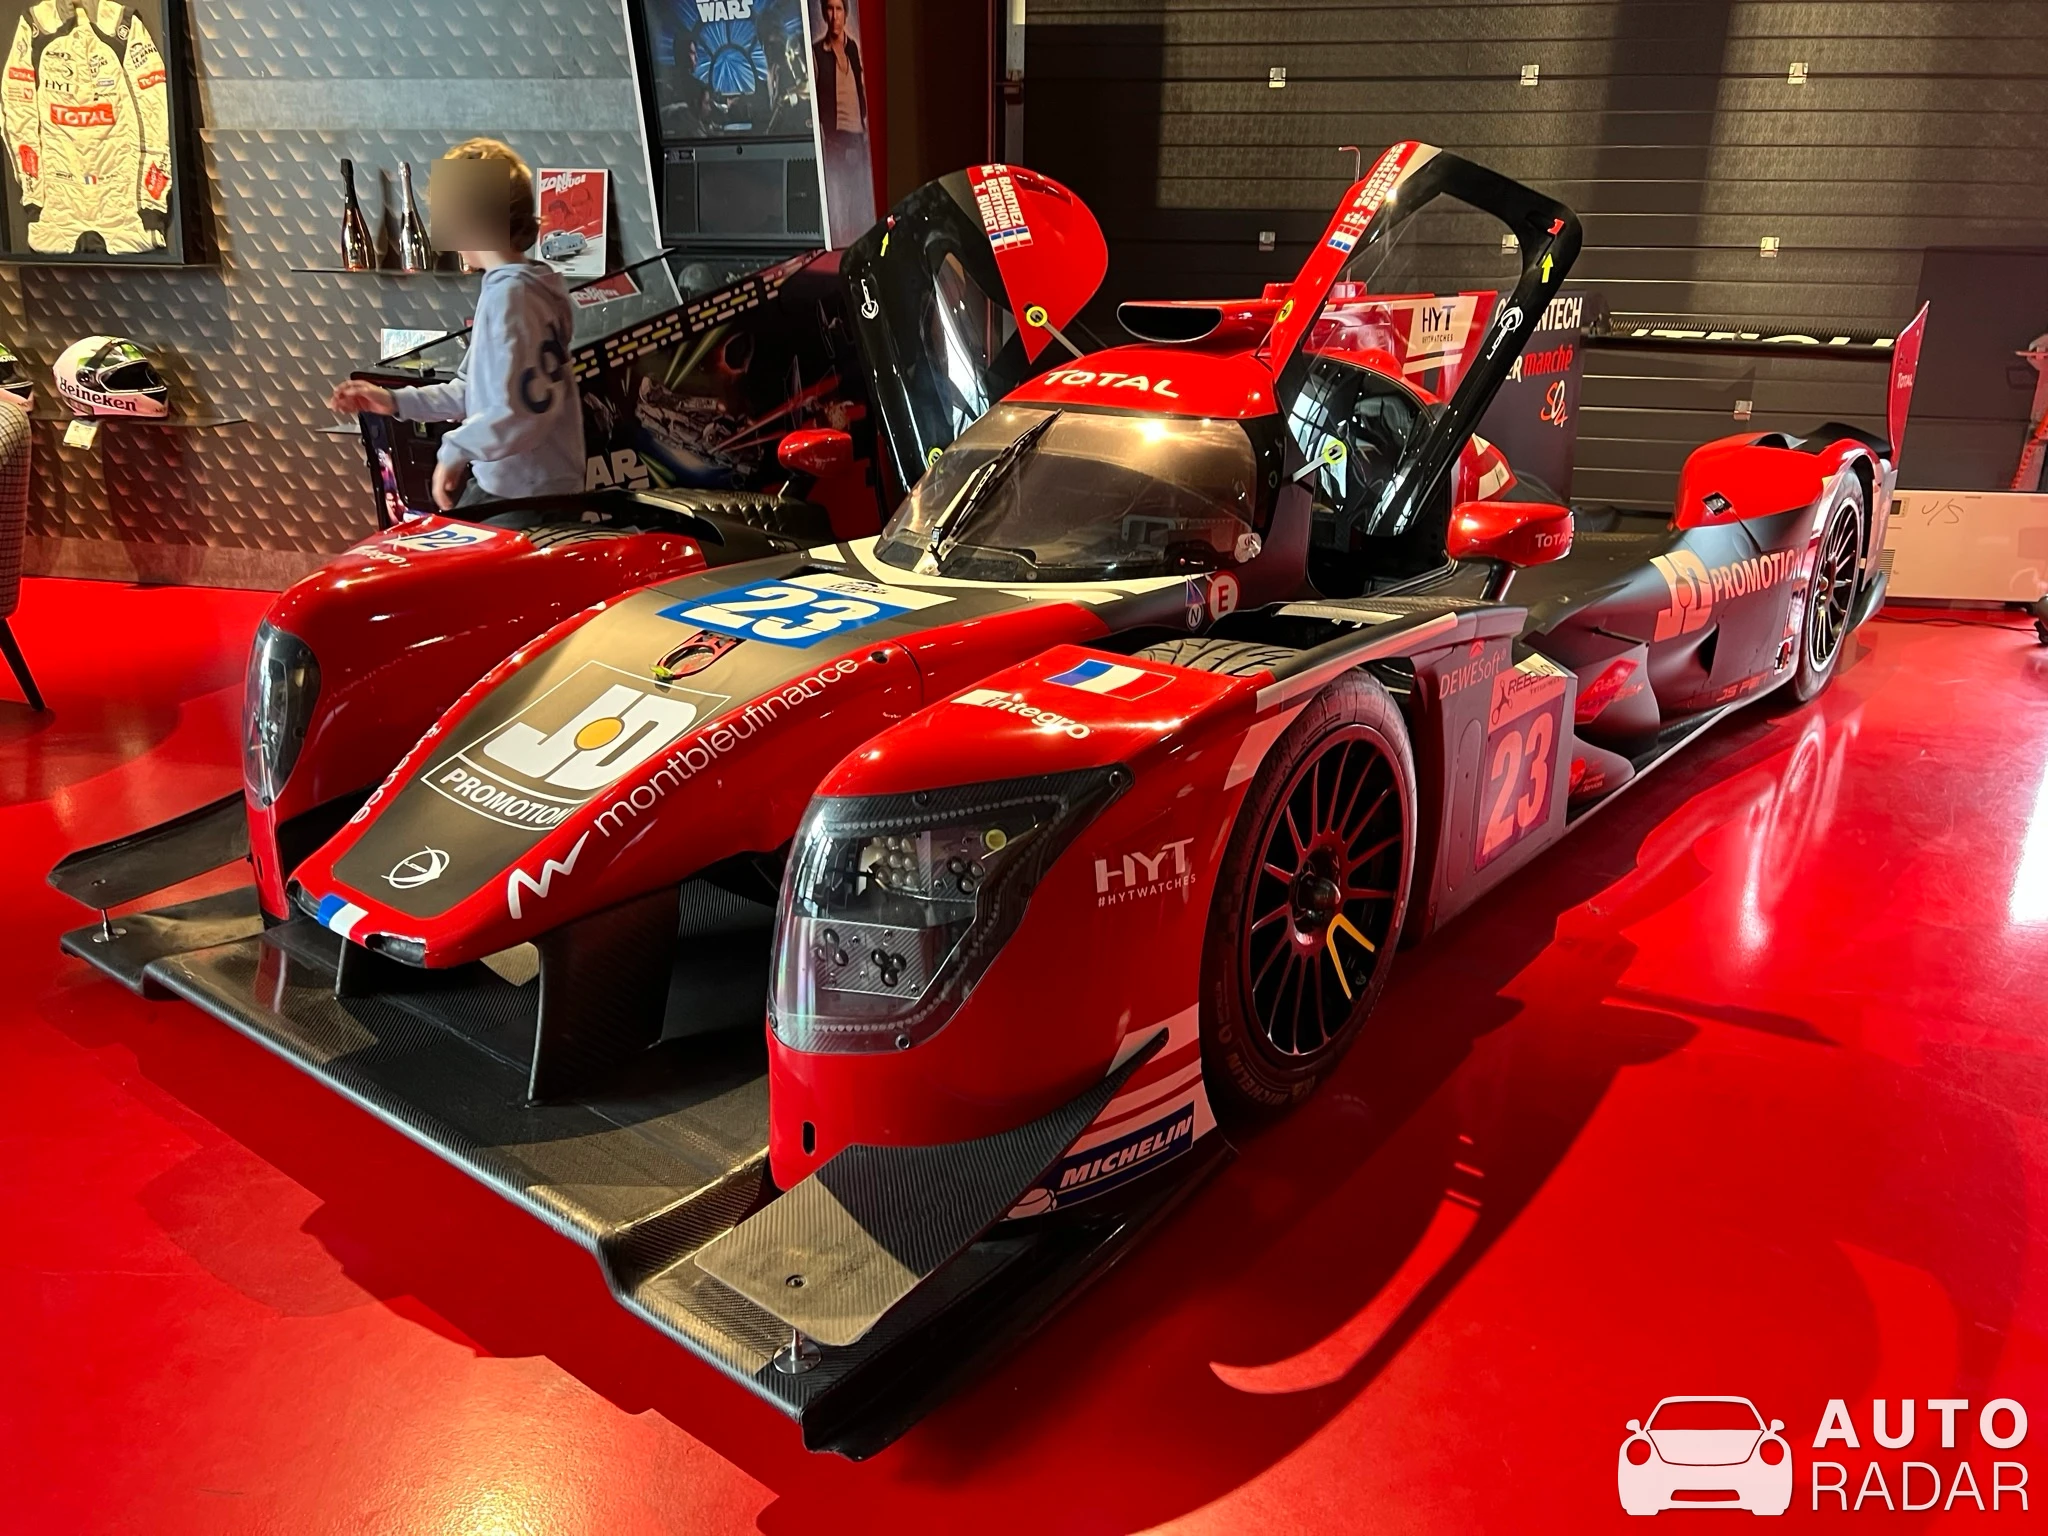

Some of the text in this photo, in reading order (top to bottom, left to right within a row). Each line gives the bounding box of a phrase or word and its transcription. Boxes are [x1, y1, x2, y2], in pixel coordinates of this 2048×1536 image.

[697, 0, 754, 22] WARS
[45, 79, 73, 92] HYT
[53, 105, 113, 125] TOTAL
[986, 178, 1012, 230] BERTHON
[998, 176, 1026, 227] BARTHEZ
[1367, 164, 1401, 211] BURET
[977, 194, 999, 232] BURET
[1422, 305, 1456, 333] HYT
[60, 376, 137, 412] Heineken
[1046, 369, 1180, 399] TOTAL
[1711, 549, 1806, 603] PROMOTION
[680, 587, 880, 640] 23
[1218, 585, 1230, 613] E
[982, 697, 1091, 739] integro
[594, 659, 859, 838] montbleufinance
[440, 768, 573, 826] PROMOTION
[1483, 712, 1554, 856] 23
[1095, 837, 1195, 893] HYT
[1098, 874, 1197, 908] #HYTWATCHES
[1060, 1115, 1193, 1188] MICHELIN
